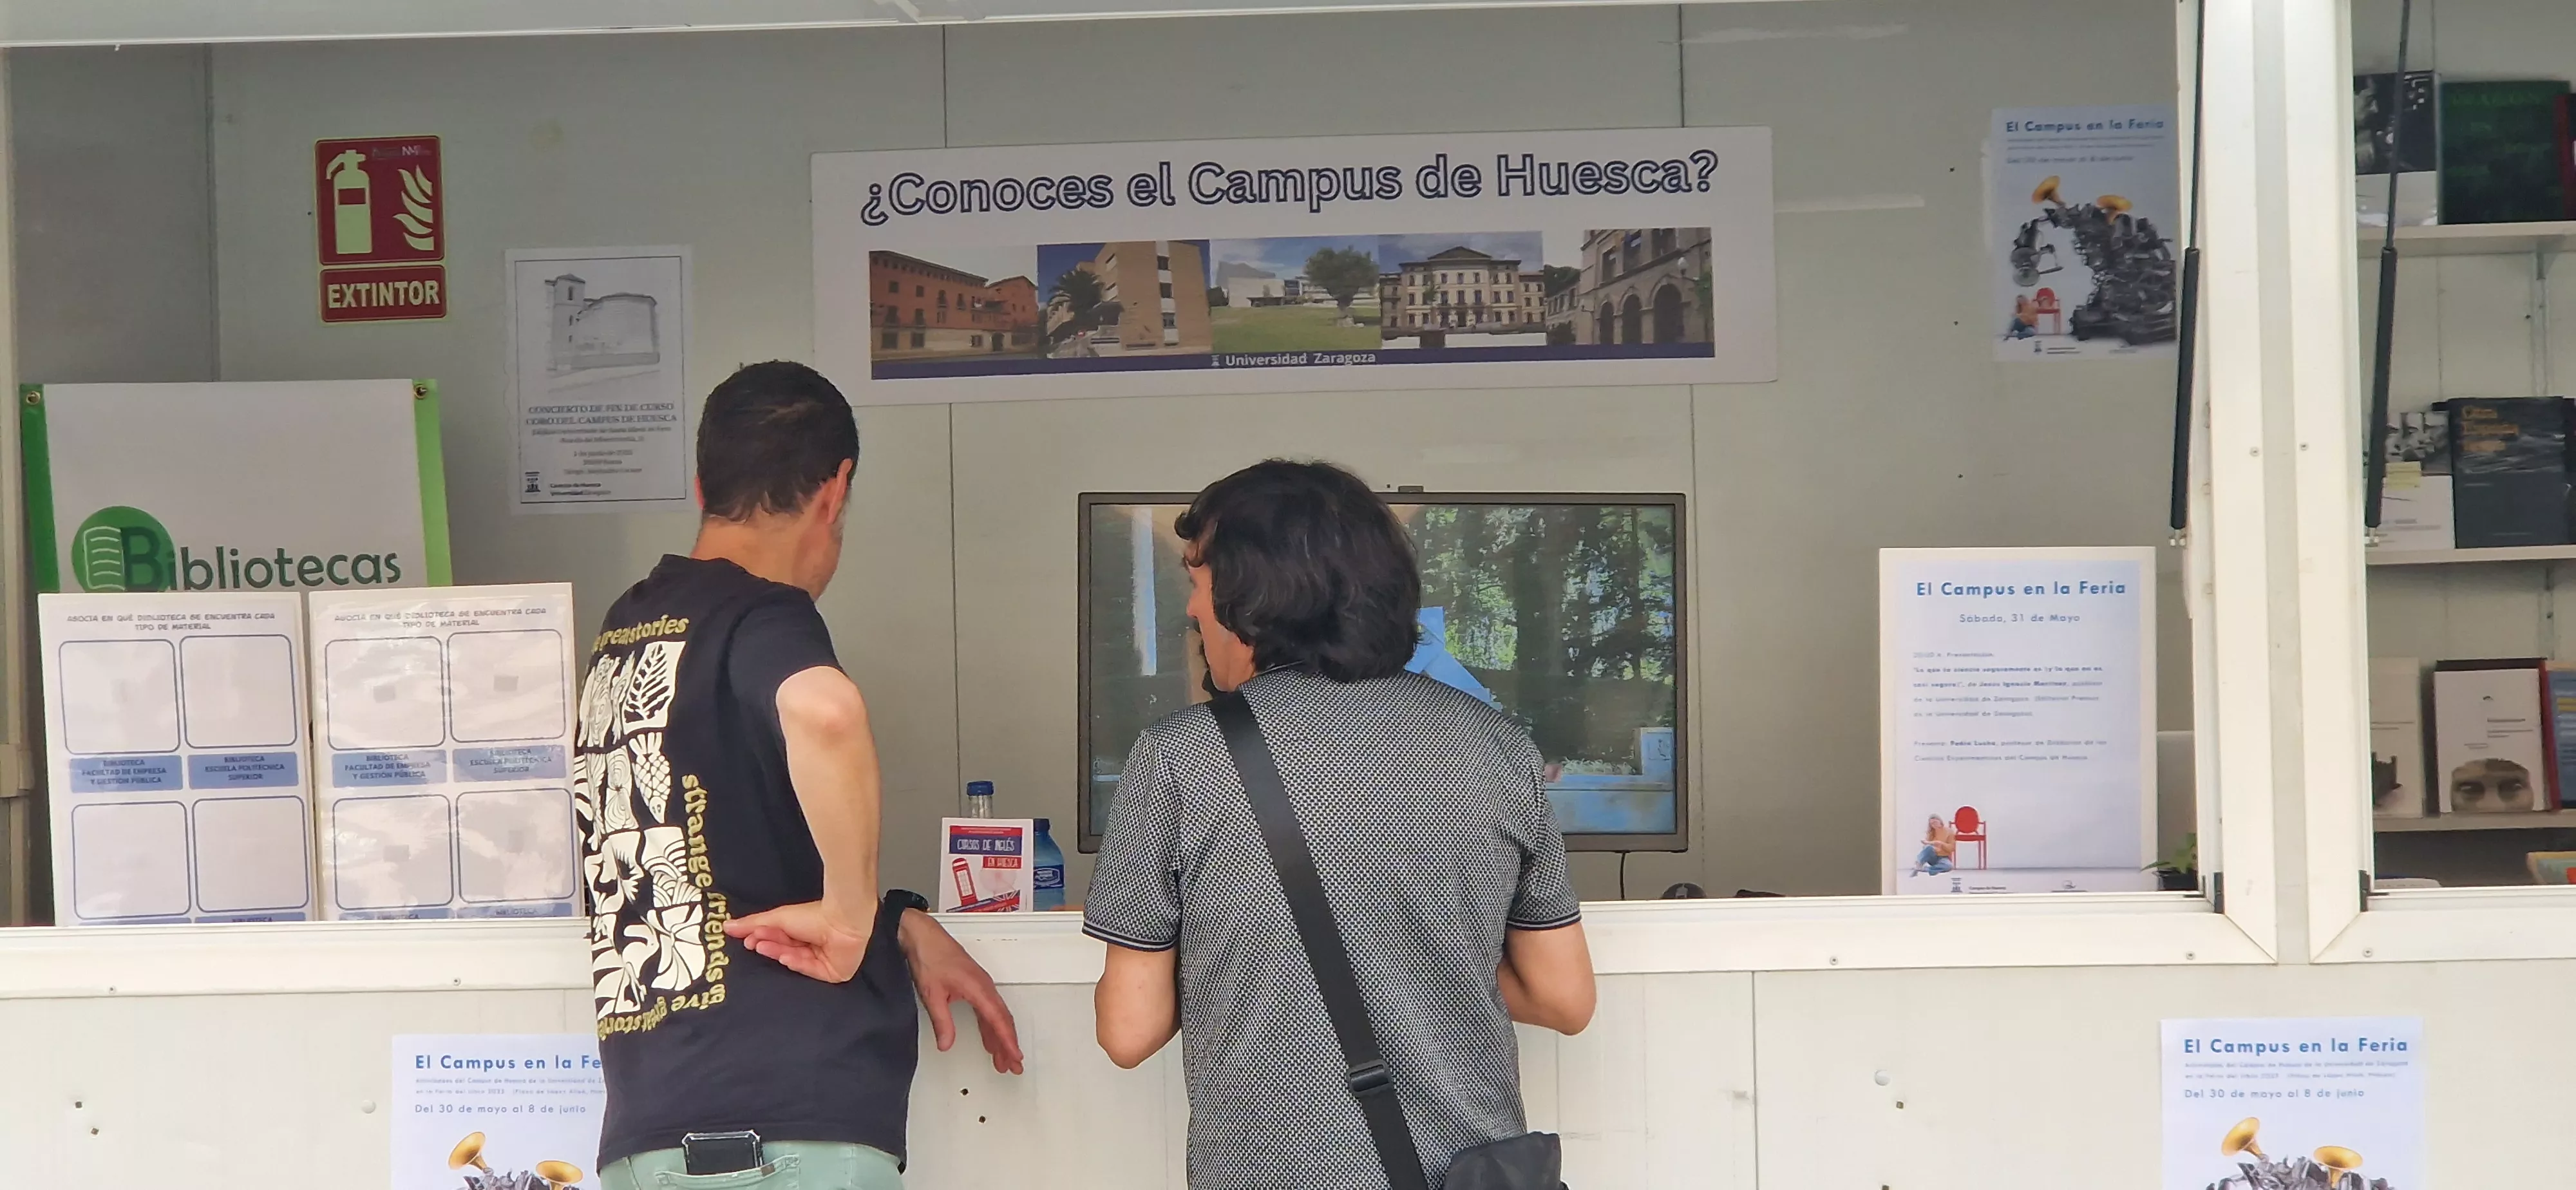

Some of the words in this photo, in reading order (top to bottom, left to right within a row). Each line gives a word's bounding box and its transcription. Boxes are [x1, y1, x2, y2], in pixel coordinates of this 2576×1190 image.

[860, 173, 1114, 227] ¿Conoces
[1127, 161, 1176, 207] el
[1188, 161, 1403, 214] Campus
[1416, 153, 1482, 198] de
[1496, 149, 1719, 196] Huesca?
[327, 280, 440, 309] EXTINTOR
[1226, 353, 1307, 366] Universidad
[1312, 352, 1376, 366] Zaragoza
[121, 526, 401, 591] Bibliotecas
[1917, 582, 1931, 596] El
[1940, 581, 2016, 599] Campus
[2023, 585, 2045, 596] en
[2054, 581, 2070, 595] la
[2078, 580, 2126, 594] Feria
[2011, 614, 2025, 622] 31
[2031, 614, 2044, 622] de
[2049, 614, 2080, 623] Mayo
[982, 839, 992, 851] DE
[681, 774, 713, 887] strange
[705, 891, 731, 983] friends
[671, 983, 726, 1012] give
[2184, 1039, 2200, 1053] El
[2211, 1039, 2290, 1056] Campus
[2299, 1042, 2322, 1053] en
[2331, 1037, 2349, 1052] la
[2358, 1037, 2407, 1052] Feria
[415, 1055, 430, 1069] El
[440, 1055, 515, 1073] Campus
[524, 1059, 545, 1069] en
[555, 1055, 572, 1069] la
[2184, 1088, 2204, 1098] Del
[2210, 1089, 2225, 1098] 30
[2231, 1089, 2245, 1098] de
[2287, 1089, 2298, 1098] al
[2317, 1088, 2331, 1097] de
[2336, 1088, 2364, 1099] junio
[415, 1104, 433, 1113] Del
[439, 1104, 453, 1113] 30
[459, 1104, 472, 1113] de
[477, 1106, 507, 1115] mayo
[513, 1104, 523, 1113] al
[528, 1104, 535, 1113] 8
[540, 1104, 554, 1113] de
[560, 1104, 586, 1115] junio
